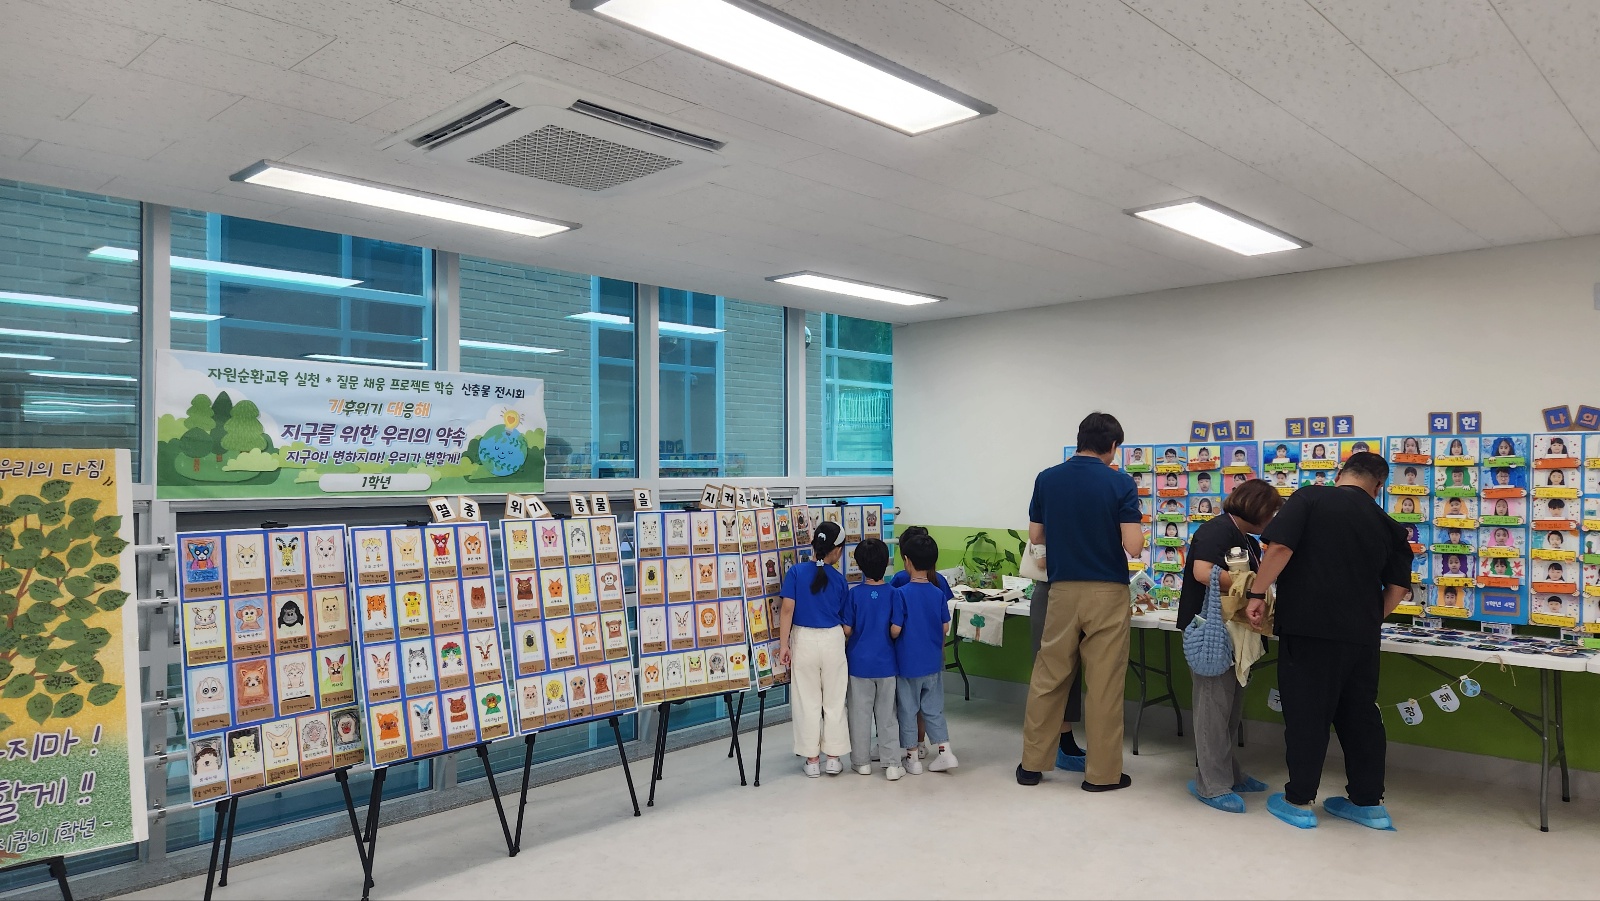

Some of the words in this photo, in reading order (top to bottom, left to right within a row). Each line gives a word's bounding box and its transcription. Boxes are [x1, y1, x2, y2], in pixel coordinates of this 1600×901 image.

[207, 367, 290, 386] 자원순환교육
[295, 372, 320, 388] 실천
[337, 374, 359, 390] 질문
[390, 378, 430, 394] 프로젝트
[434, 381, 454, 395] 학습
[461, 383, 491, 398] 산출물
[494, 386, 525, 399] 전시회
[328, 399, 384, 416] 기후위기
[386, 401, 432, 419] 대응해
[281, 423, 336, 444] 지구를
[340, 424, 378, 445] 위한
[381, 425, 432, 446] 우리의
[436, 427, 466, 447] 약속
[1194, 425, 1250, 438] 에너지
[1290, 419, 1350, 435] 절약을
[1433, 415, 1478, 431] 위한
[1550, 413, 1598, 426] 나의
[286, 450, 329, 464] 지구야!
[332, 450, 384, 465] 변하지마!
[388, 451, 422, 464] 우리가
[425, 451, 461, 465] 변할게!
[0, 459, 53, 479] 우리의
[62, 460, 104, 479] 다짐
[362, 475, 392, 490] 1학년
[435, 502, 477, 518] 멸종
[511, 500, 543, 514] 위기
[0, 729, 79, 761] 지마
[54, 817, 96, 843] 1학년
